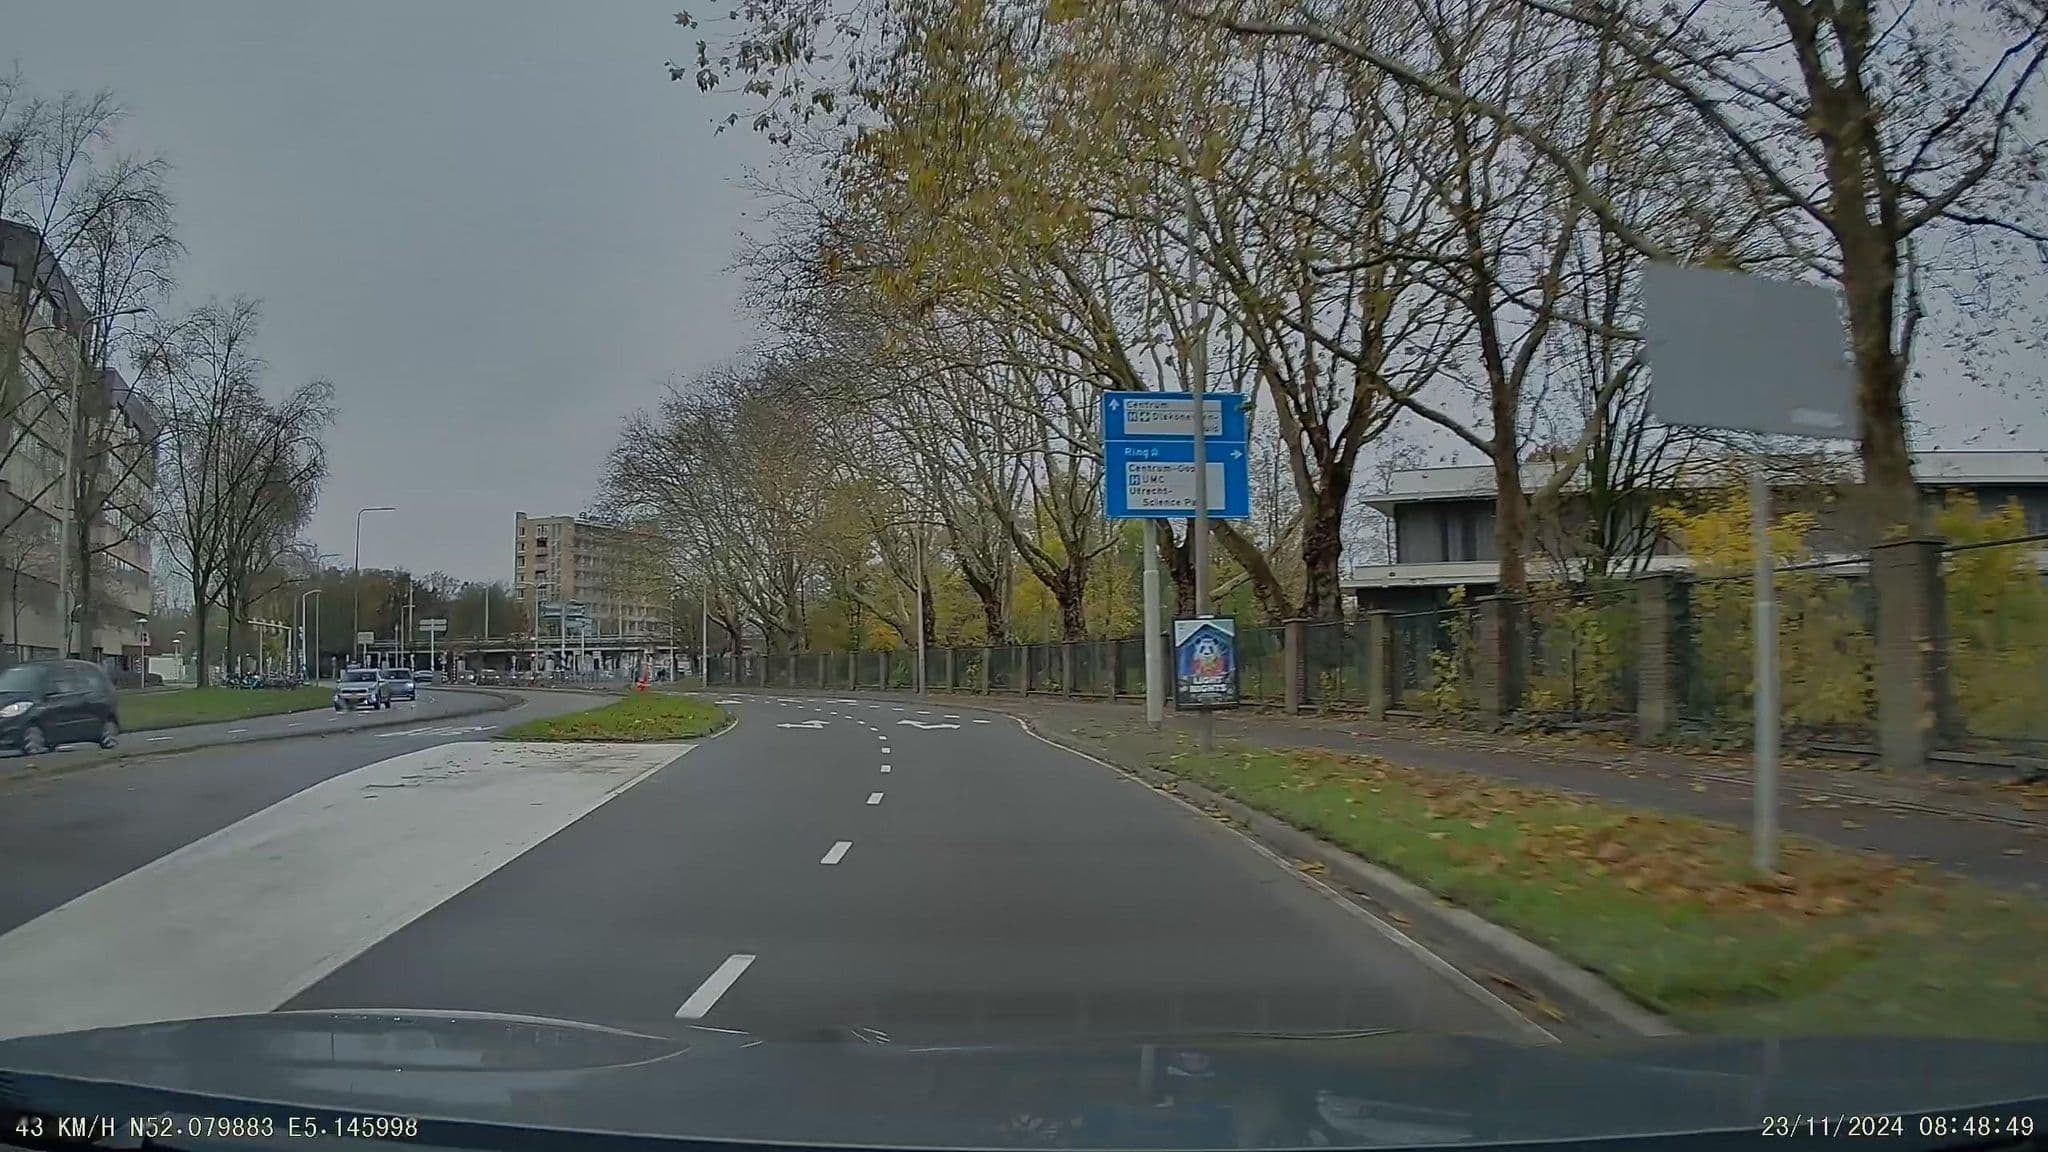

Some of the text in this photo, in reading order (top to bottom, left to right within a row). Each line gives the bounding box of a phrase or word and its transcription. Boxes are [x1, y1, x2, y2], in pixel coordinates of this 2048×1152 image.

[1127, 401, 1168, 409] Centrum
[1124, 447, 1149, 458] Ring
[1128, 464, 1198, 473] Centrum-Oos
[1142, 474, 1165, 483] UMC
[1129, 487, 1173, 495] Utrecht-
[1143, 498, 1181, 506] Science
